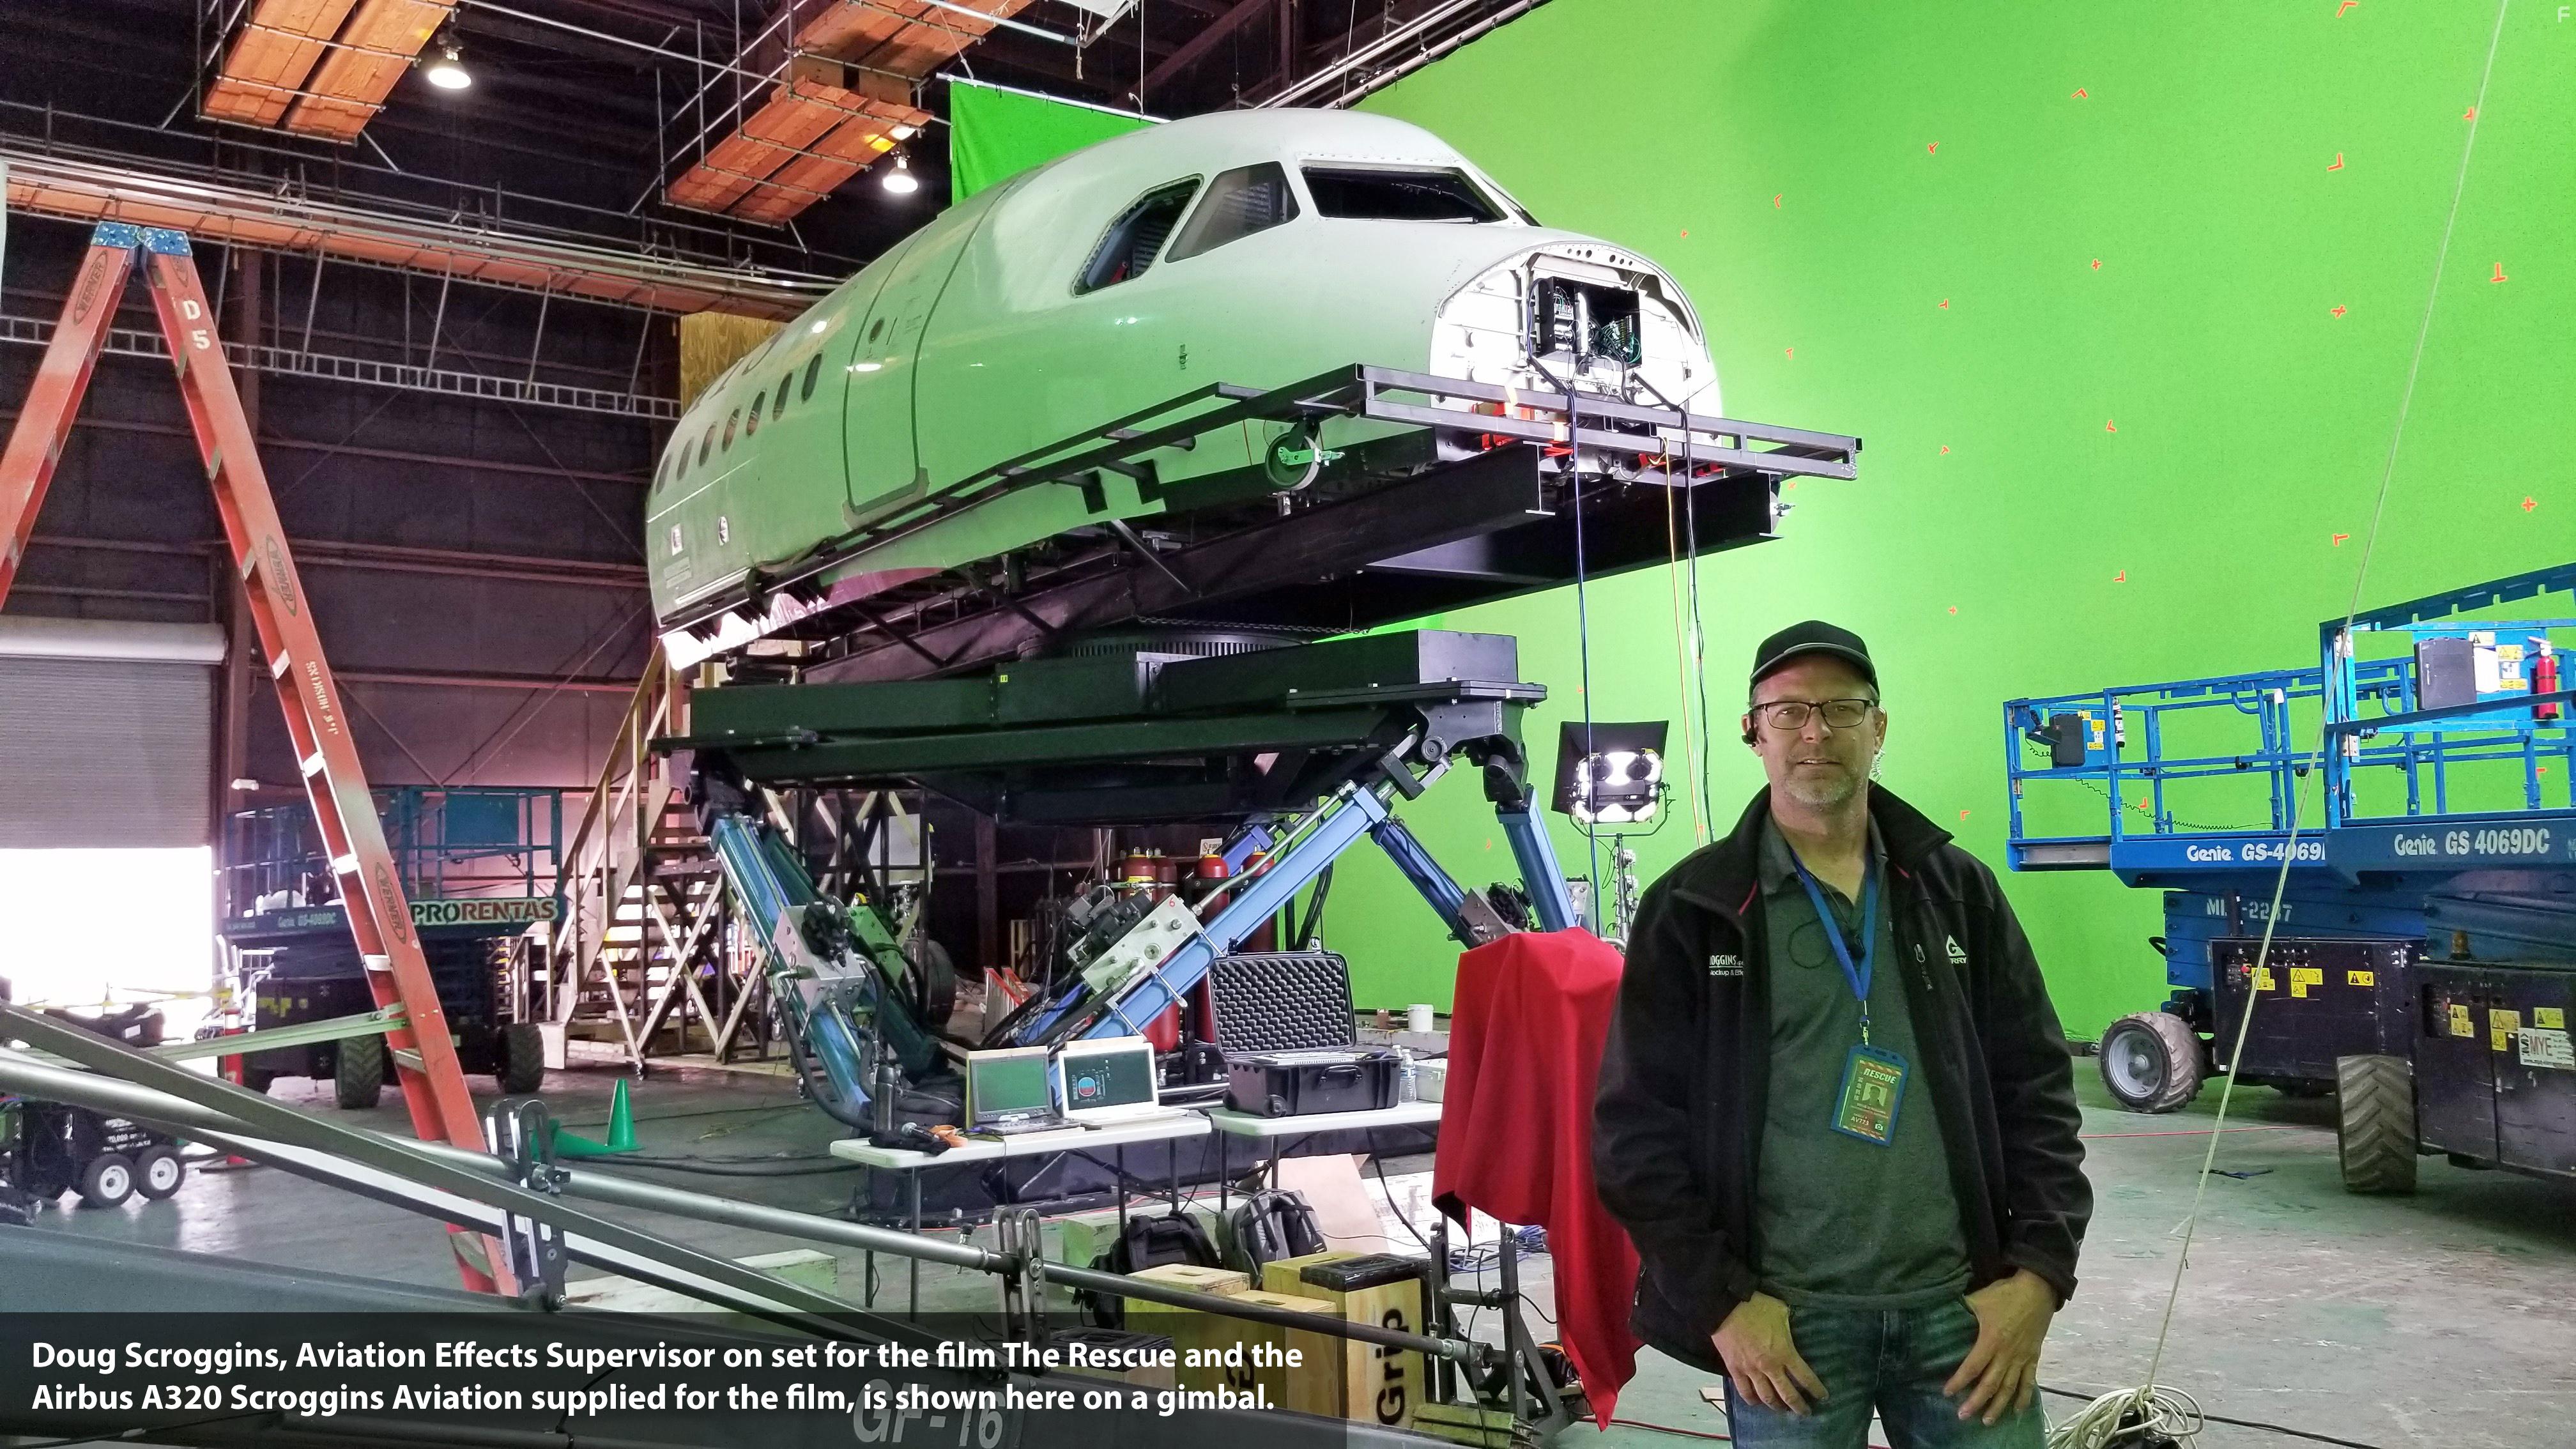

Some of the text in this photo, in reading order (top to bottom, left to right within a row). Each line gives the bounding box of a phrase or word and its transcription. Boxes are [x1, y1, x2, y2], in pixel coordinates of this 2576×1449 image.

[183, 299, 201, 319] D
[192, 329, 211, 349] 5
[2186, 842, 2326, 862] Genie GS-4069
[2395, 832, 2437, 856] Genie
[2445, 831, 2470, 855] GS
[2474, 828, 2550, 854] 4069DC
[410, 900, 555, 922] PRORENTAS
[1710, 954, 1737, 966] OGGINS
[1863, 1068, 1897, 1084] RESCUE
[1376, 1308, 1409, 1425] Grip
